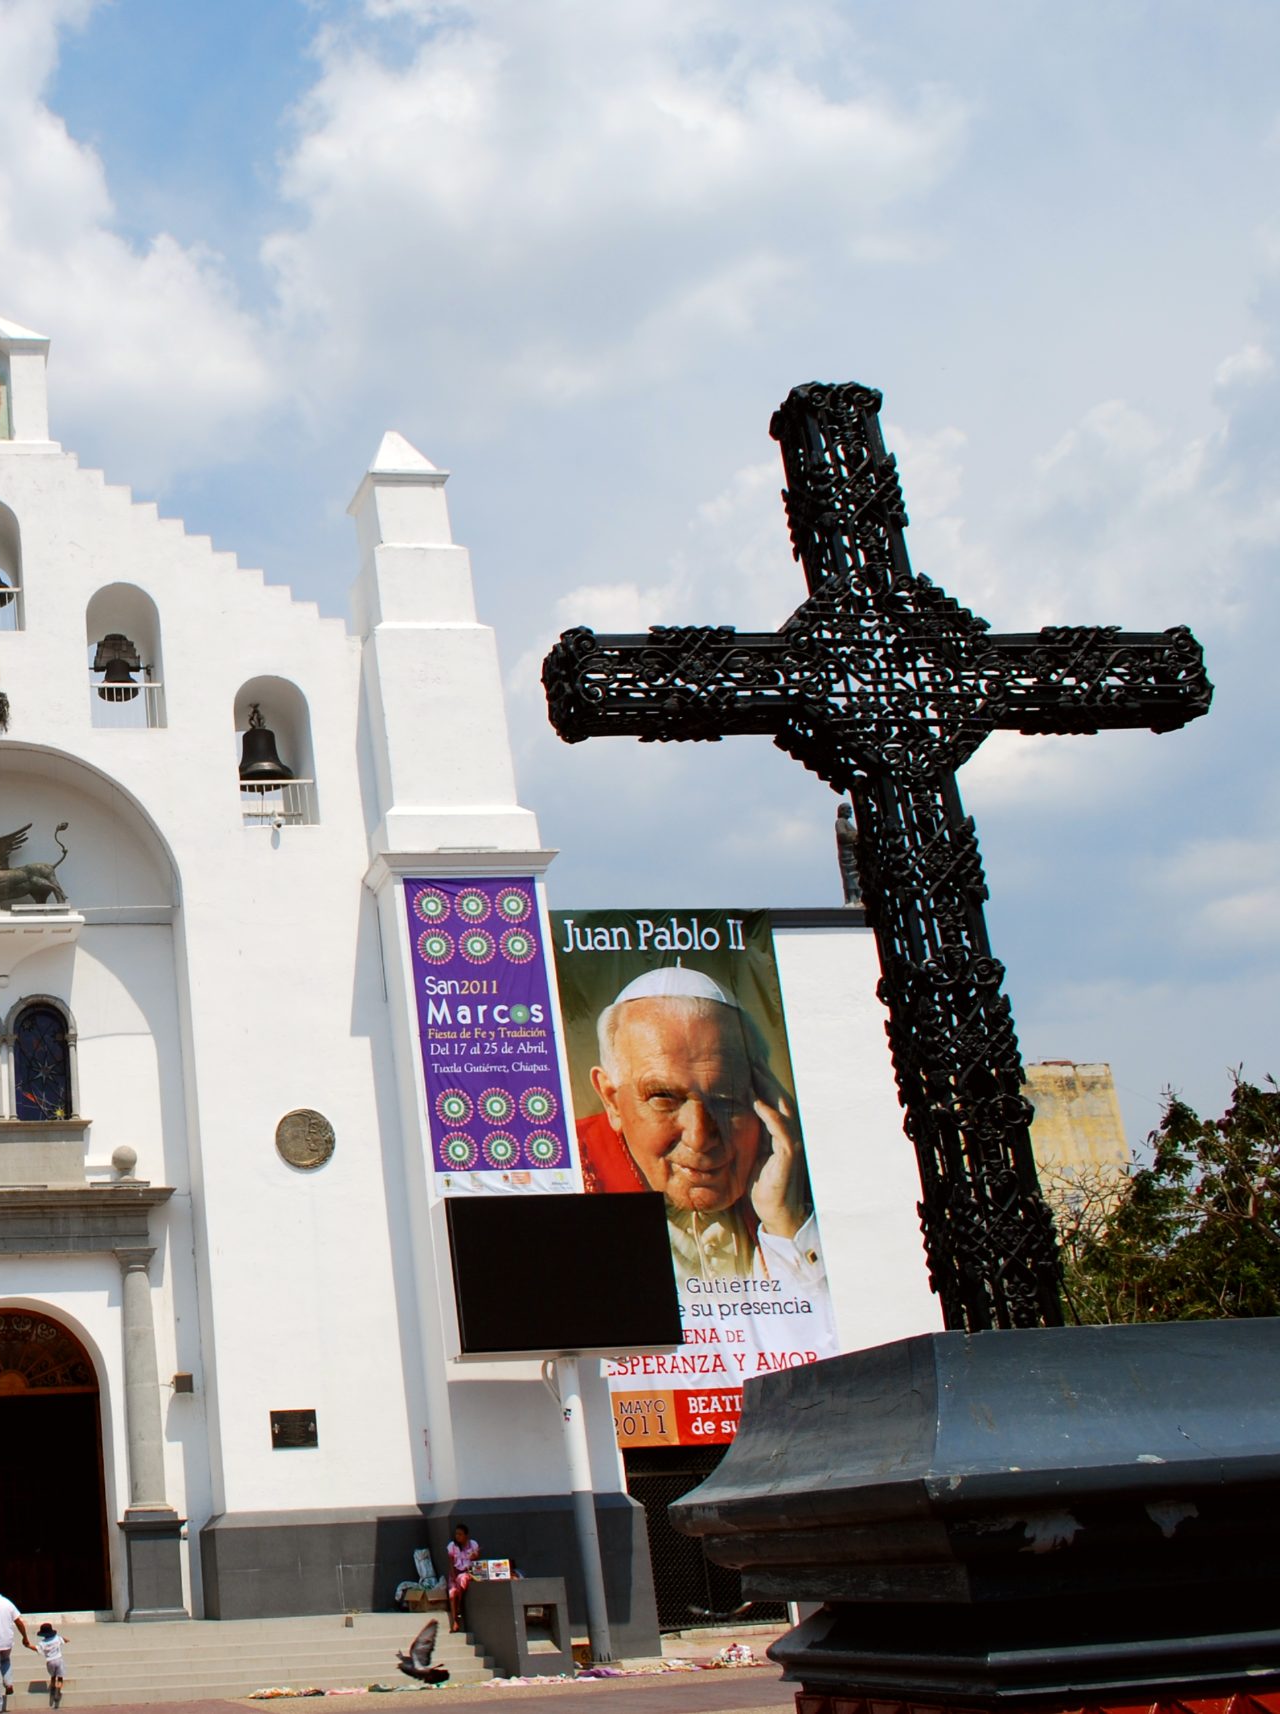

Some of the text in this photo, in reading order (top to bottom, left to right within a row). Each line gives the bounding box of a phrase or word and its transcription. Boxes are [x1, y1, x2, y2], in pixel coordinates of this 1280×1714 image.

[563, 917, 746, 953] Juan Pablo II
[424, 975, 499, 995] San 2011
[427, 1026, 547, 1041] Fiesta de Fe y Tradición
[430, 1040, 549, 1056] Del 17 al 25 de Abril,
[431, 1060, 552, 1075] Tuxtla Gutiérrez, Chiapas.
[686, 1277, 782, 1294] Gutiérrez
[679, 1297, 813, 1320] e su presencia
[683, 1328, 746, 1345] ENA DE
[733, 1353, 746, 1372] Y
[620, 1400, 666, 1415] MAYO
[687, 1394, 743, 1415] BEATI
[691, 1416, 716, 1435] de
